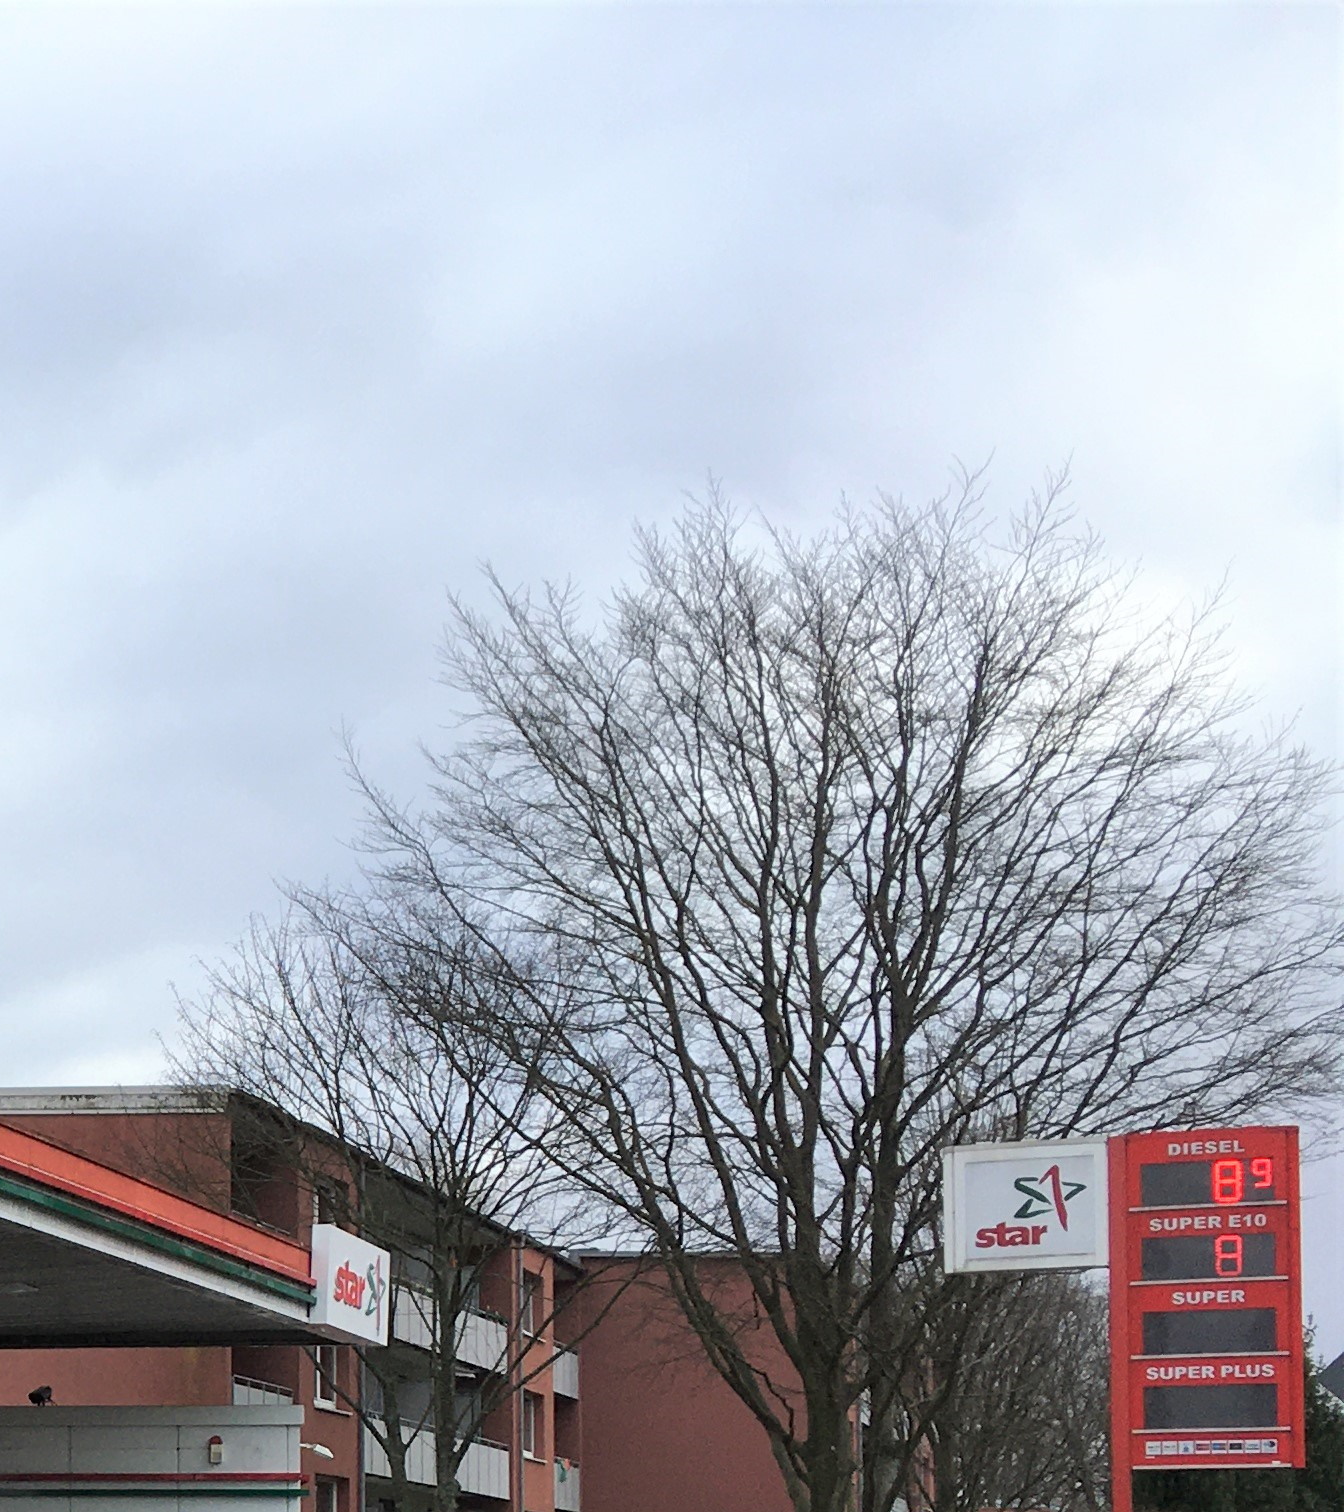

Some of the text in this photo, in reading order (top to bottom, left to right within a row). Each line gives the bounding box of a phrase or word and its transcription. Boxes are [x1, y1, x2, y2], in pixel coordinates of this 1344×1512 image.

[1168, 1140, 1245, 1156] DIESEL
[1149, 1214, 1267, 1231] SUPER E10
[975, 1221, 1048, 1249] star
[1215, 1235, 1242, 1277] 8
[333, 1260, 366, 1310] star
[1172, 1290, 1245, 1305] SUPER
[1146, 1364, 1275, 1380] SUPER PLUS
